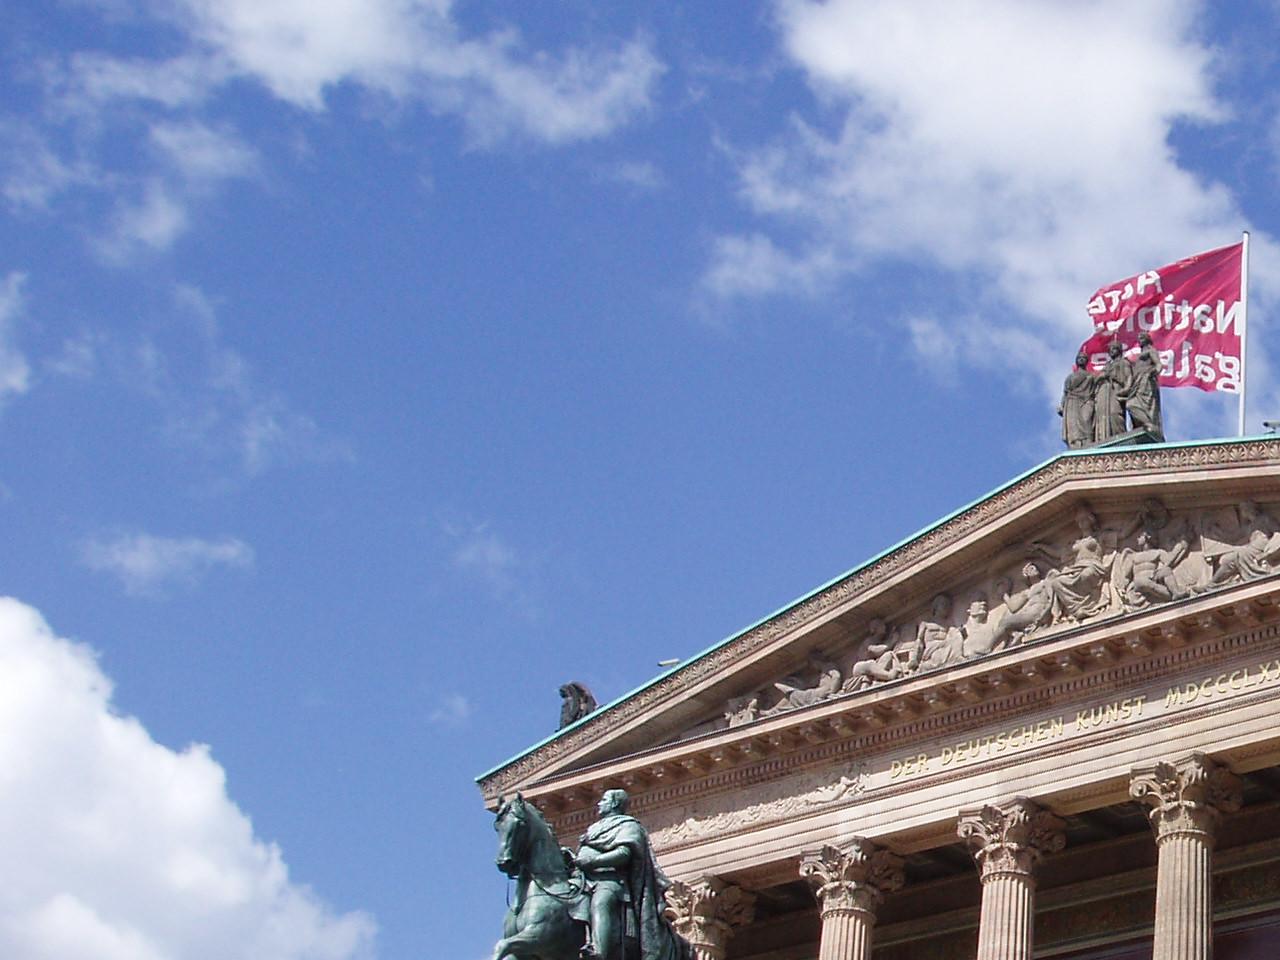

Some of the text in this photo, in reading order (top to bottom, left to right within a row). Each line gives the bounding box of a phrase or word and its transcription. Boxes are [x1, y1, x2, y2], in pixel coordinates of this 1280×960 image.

[890, 753, 930, 779] DER
[941, 716, 1065, 766] DEUTSCHEN
[1075, 694, 1148, 732] KUNST
